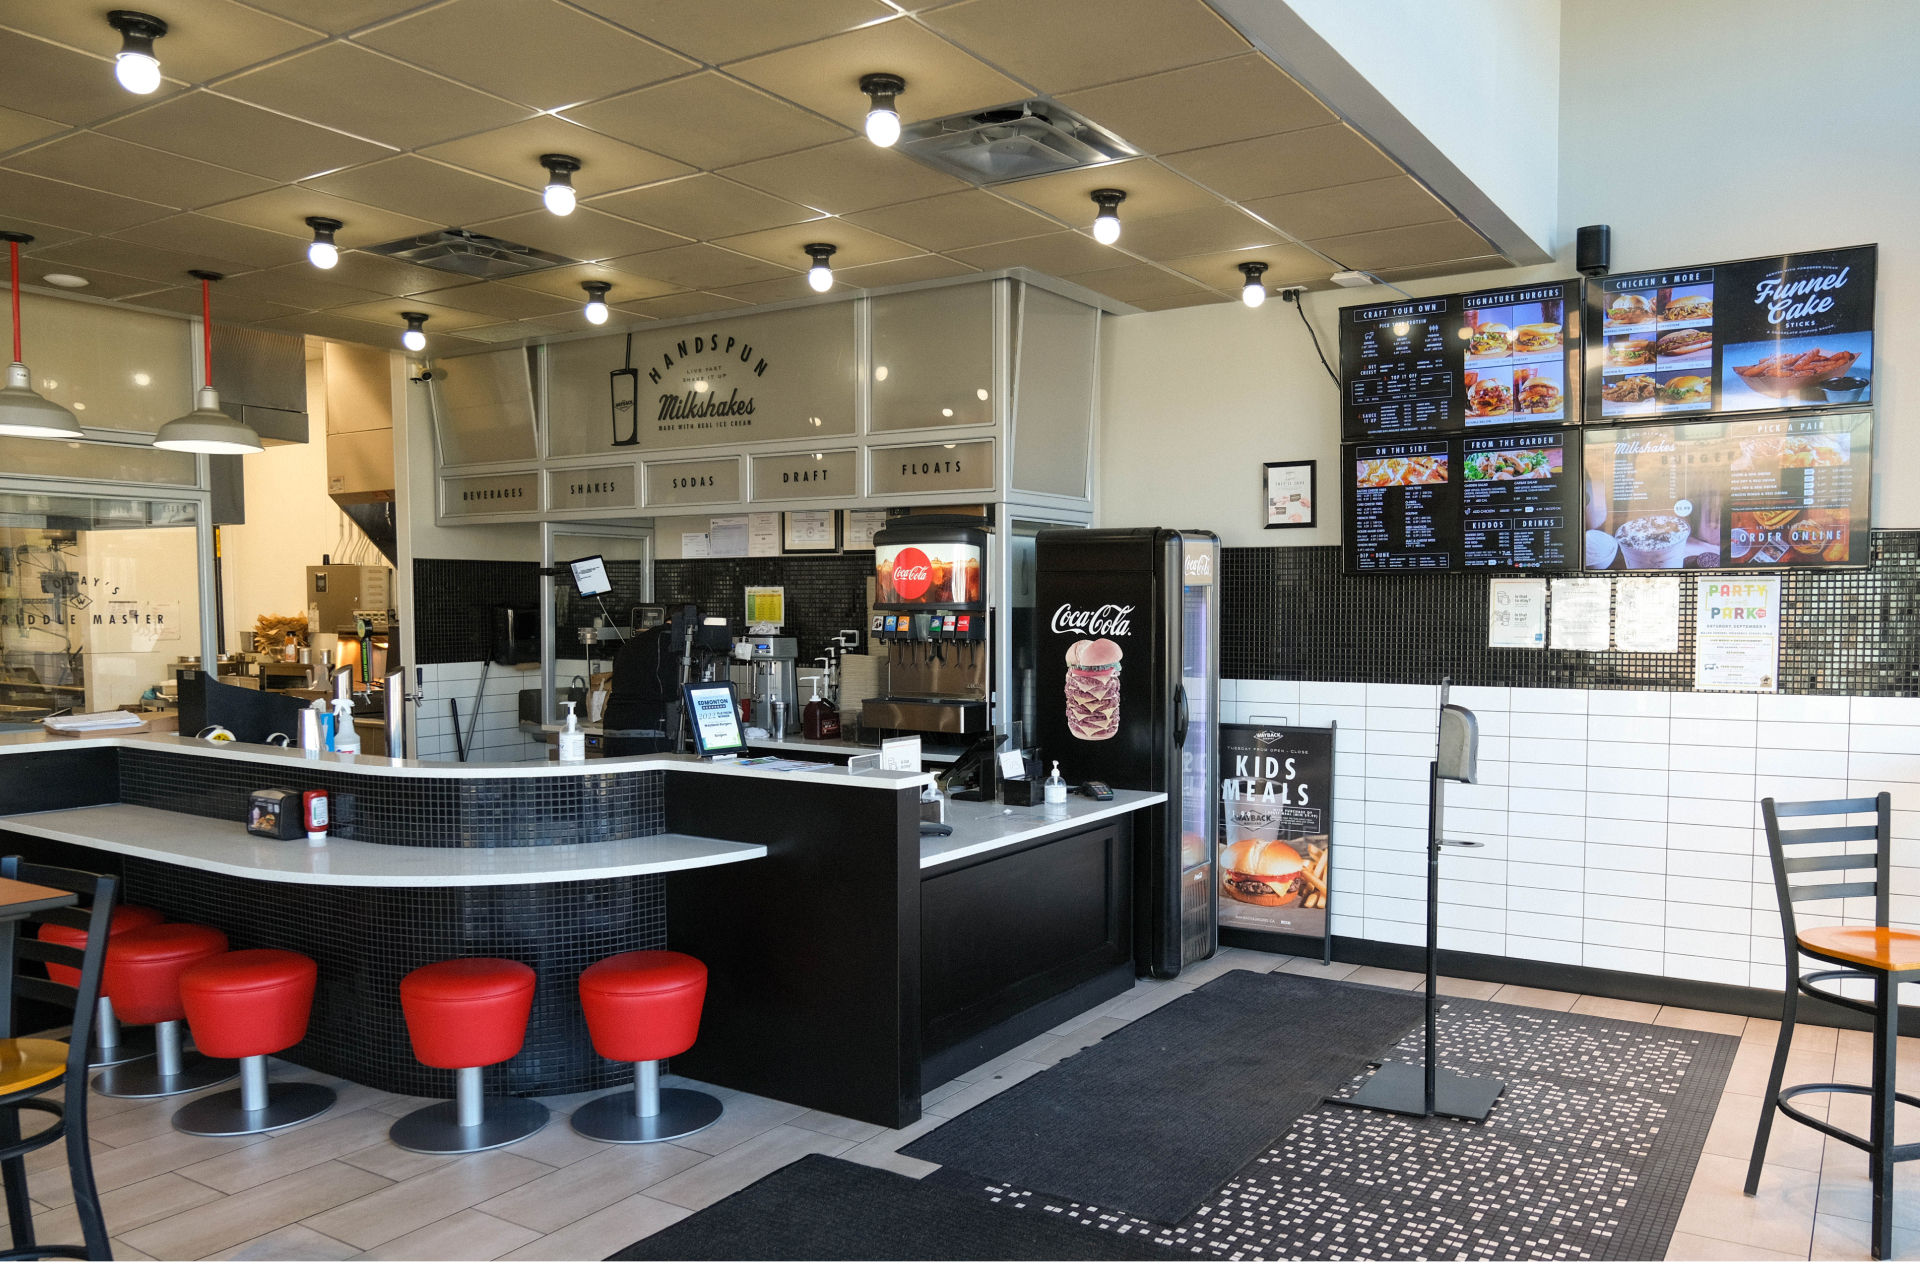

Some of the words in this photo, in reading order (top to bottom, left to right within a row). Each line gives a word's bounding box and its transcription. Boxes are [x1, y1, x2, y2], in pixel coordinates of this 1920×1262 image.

[1616, 278, 1656, 289] CHICKEN
[1661, 276, 1667, 284] &
[1673, 272, 1700, 283] MORE
[1754, 266, 1850, 304] Funnel
[1467, 294, 1515, 306] SIGNATURE
[1520, 288, 1560, 300] BURGERS
[1363, 309, 1388, 319] CRAFT
[1392, 306, 1413, 315] YOUR
[1418, 303, 1437, 313] OWN
[1767, 294, 1835, 324] Cake
[1785, 320, 1815, 328] STICKS
[648, 333, 768, 385] HANDSPUN
[705, 365, 722, 373] FAST
[658, 388, 756, 421] Milkshakes
[1757, 423, 1781, 434] PICK
[1788, 423, 1794, 432] A
[1800, 421, 1825, 431] PAIR
[1471, 440, 1494, 449] FROM
[1500, 439, 1514, 447] THE
[1519, 436, 1554, 446] GARDEN
[1614, 440, 1676, 455] Milkshakes
[1376, 447, 1387, 455] ON
[1390, 446, 1405, 455] THE
[1410, 445, 1428, 453] SIDE
[902, 460, 961, 476] FLOATS
[672, 475, 714, 489] SODAS
[783, 469, 828, 483] DRAFT
[463, 487, 523, 500] BEVERAGES
[570, 481, 615, 495] SHAKES
[1472, 521, 1504, 530] KIDDOS
[1522, 519, 1554, 527] DRINKS
[1740, 532, 1782, 543] ORDER
[1791, 530, 1842, 541] ONLINE
[1184, 554, 1211, 576] Coca-Cola
[894, 566, 929, 580] Coca-Cola
[1709, 584, 1767, 597] PARTY
[93, 614, 164, 625] MASTER
[1051, 603, 1136, 636] Coca-Cola
[1711, 607, 1757, 620] PARK
[1236, 754, 1296, 780] KIDS
[1222, 778, 1309, 806] MEALS
[1233, 814, 1272, 822] WAYBACK
